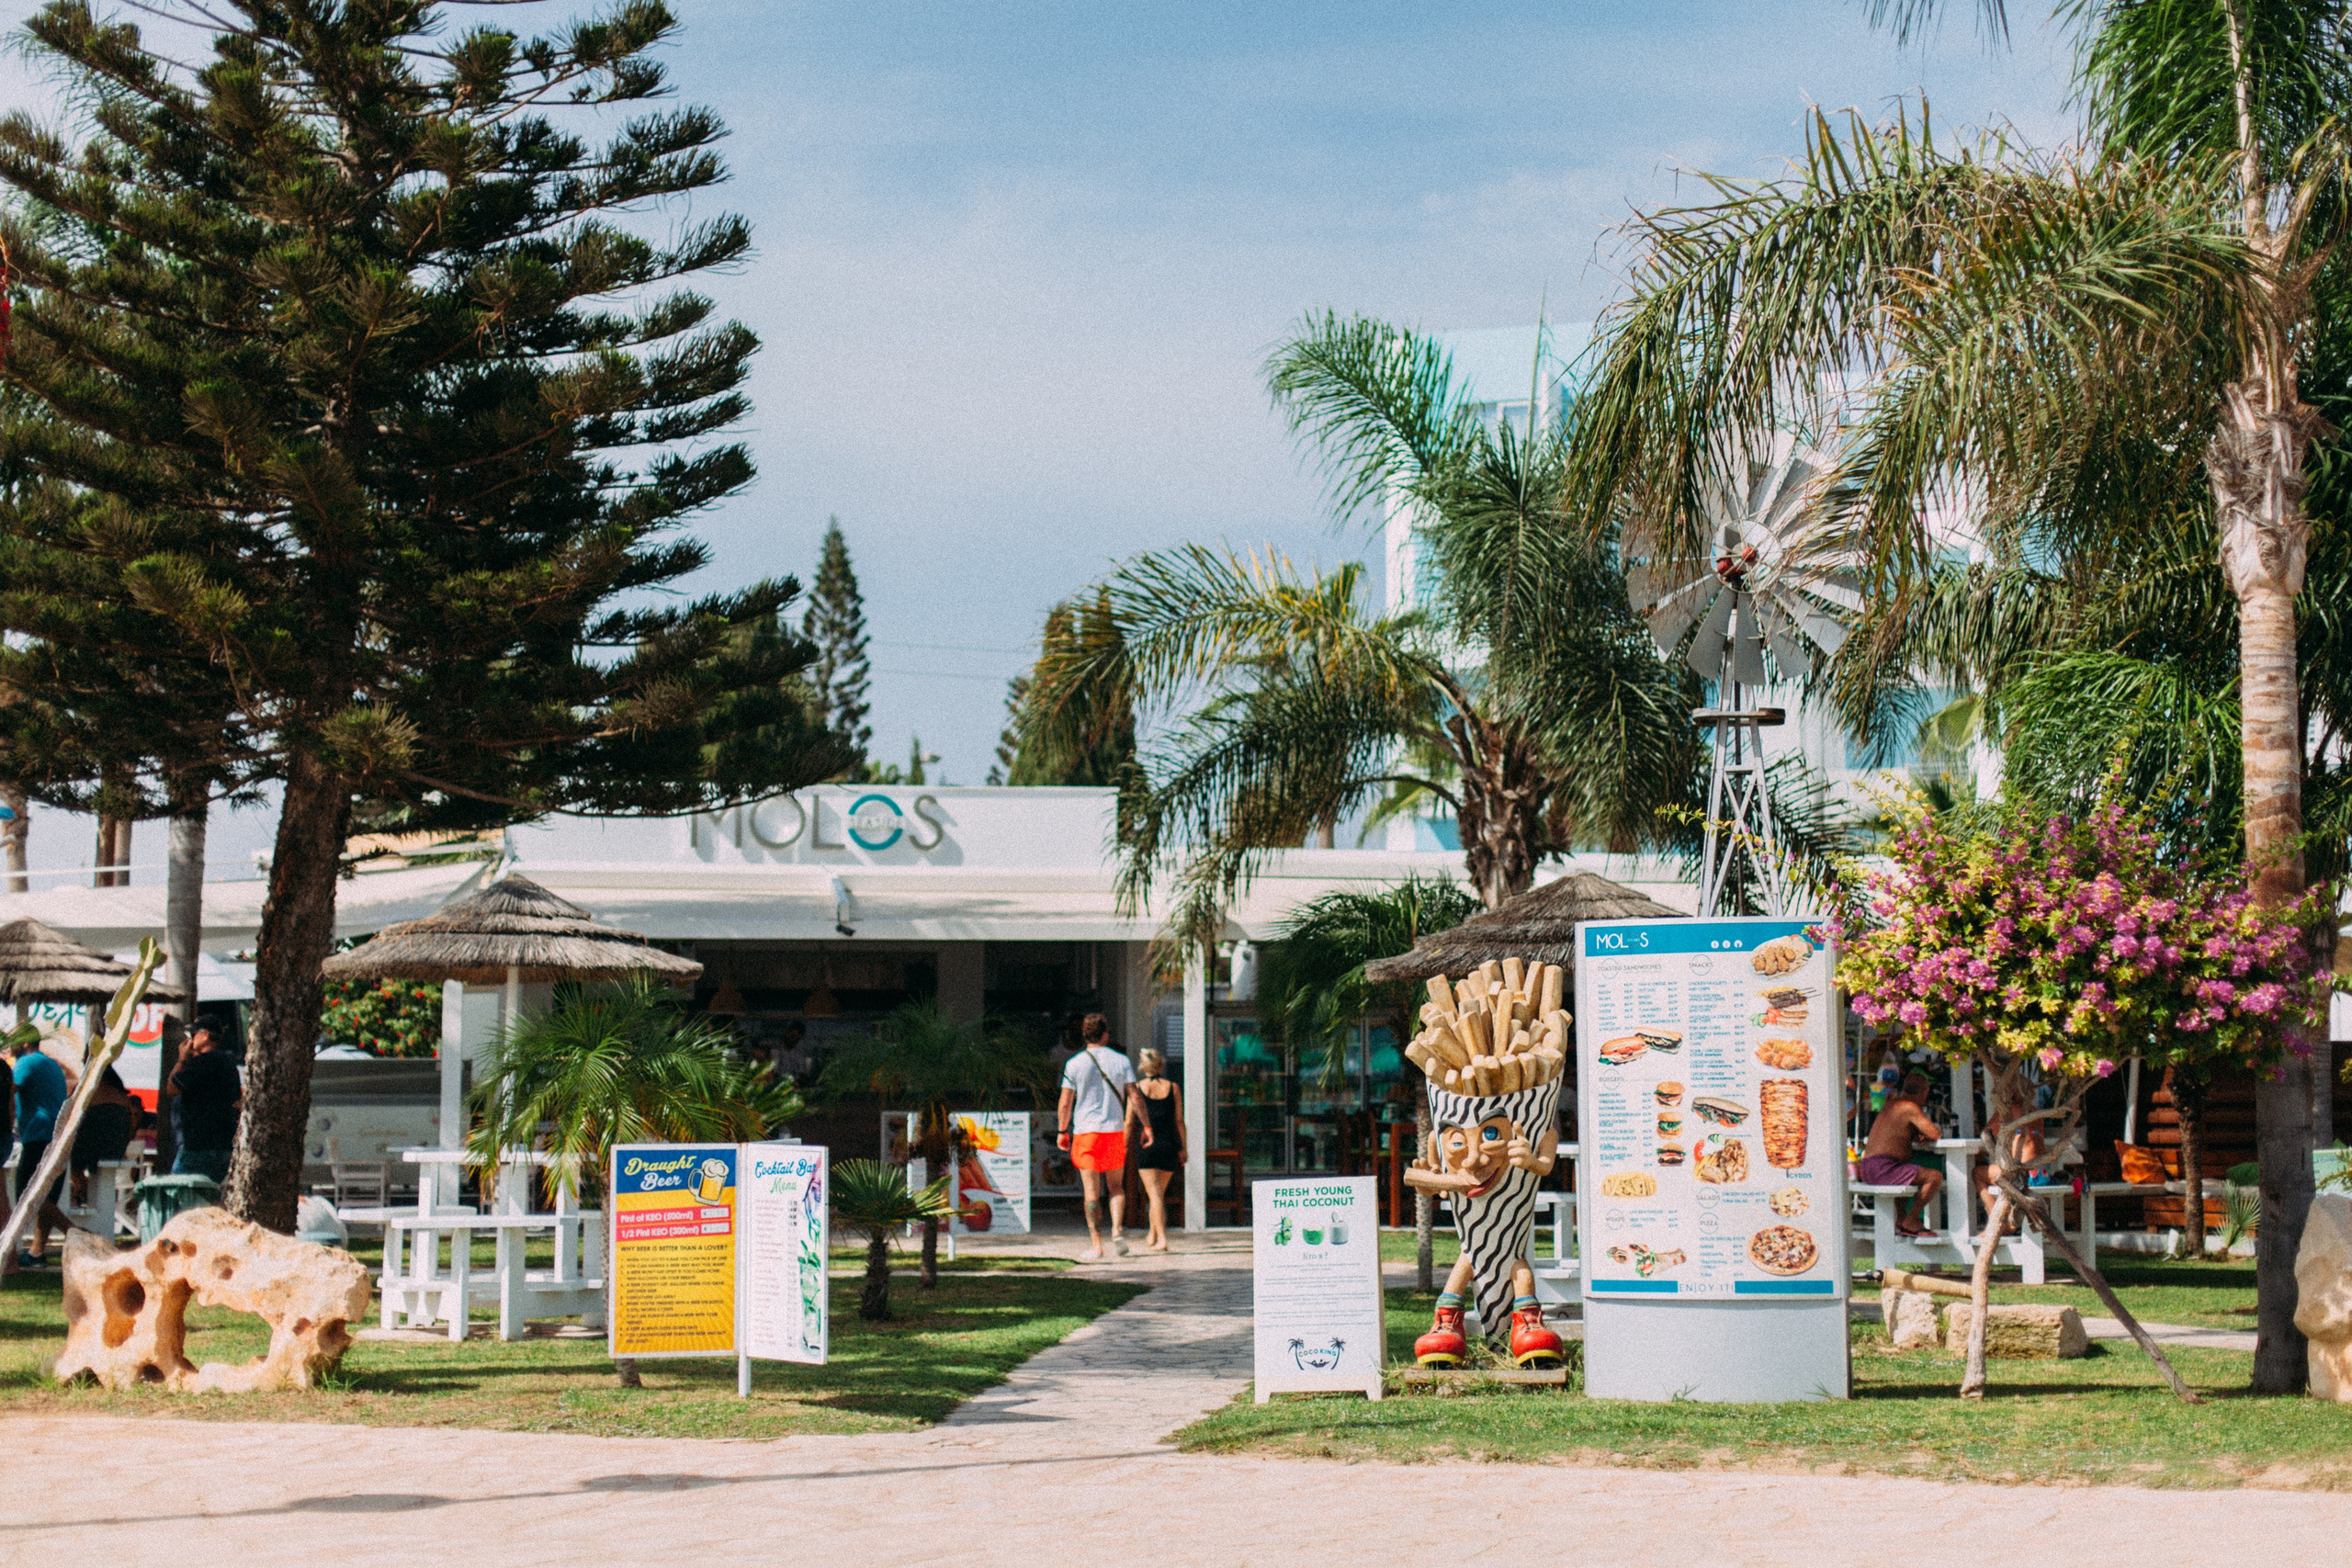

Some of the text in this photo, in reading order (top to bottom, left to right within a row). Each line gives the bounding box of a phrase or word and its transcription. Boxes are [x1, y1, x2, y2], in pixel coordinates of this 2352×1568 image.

[691, 794, 944, 851] MOLOS
[625, 1155, 697, 1176] Draught
[754, 1158, 817, 1179] Cocktail Bar
[640, 1172, 682, 1190] Beer
[770, 1178, 797, 1194] Menu
[1274, 1186, 1352, 1197] FRESH YOUNG
[1272, 1197, 1354, 1208] THAI COCONUT
[636, 1213, 644, 1222] of
[622, 1230, 635, 1238] 1/2
[636, 1228, 650, 1236] Pint
[1679, 1283, 1713, 1292] ENJOY
[1298, 1348, 1336, 1357] COCO KING
